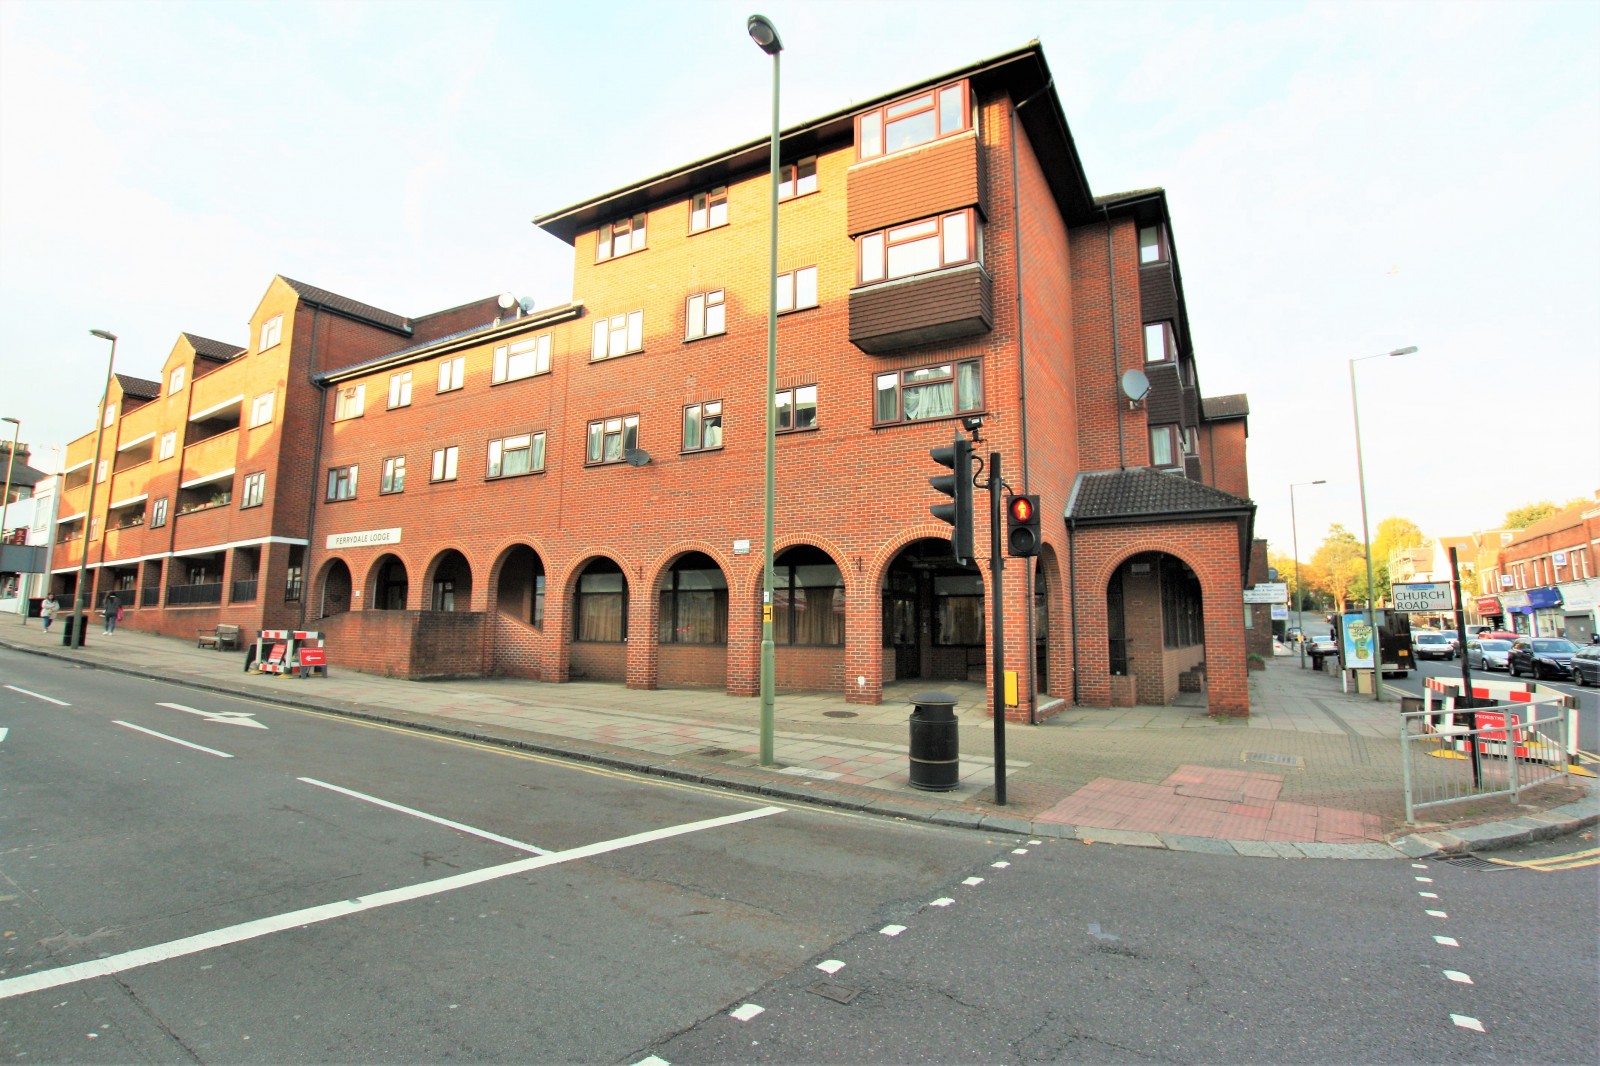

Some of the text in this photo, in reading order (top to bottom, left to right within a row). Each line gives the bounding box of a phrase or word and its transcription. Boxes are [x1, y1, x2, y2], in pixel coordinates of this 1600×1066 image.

[335, 533, 391, 545] FERRYDALE LODGE
[1395, 591, 1445, 601] CHURCH
[1397, 600, 1429, 610] ROAD
